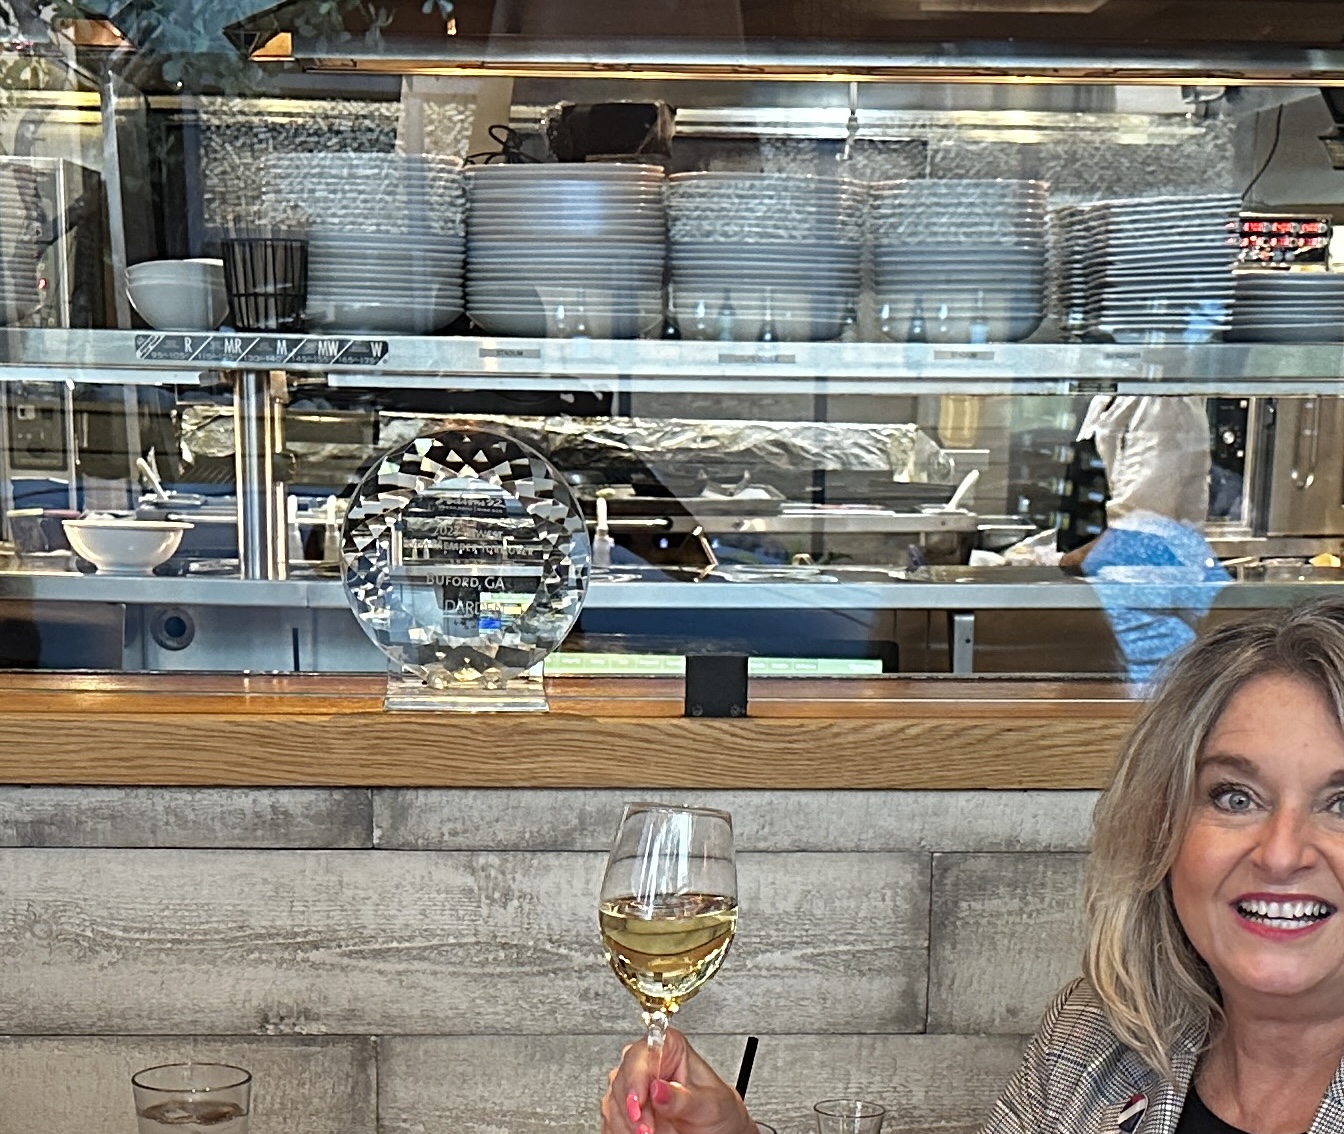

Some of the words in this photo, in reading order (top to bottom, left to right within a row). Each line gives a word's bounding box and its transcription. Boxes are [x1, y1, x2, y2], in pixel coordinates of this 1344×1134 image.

[184, 337, 193, 353] R
[224, 338, 243, 354] MR
[276, 340, 288, 355] M
[317, 340, 340, 357] MW
[370, 341, 383, 358] W
[426, 572, 482, 590] BUFORD,
[484, 576, 505, 590] GA
